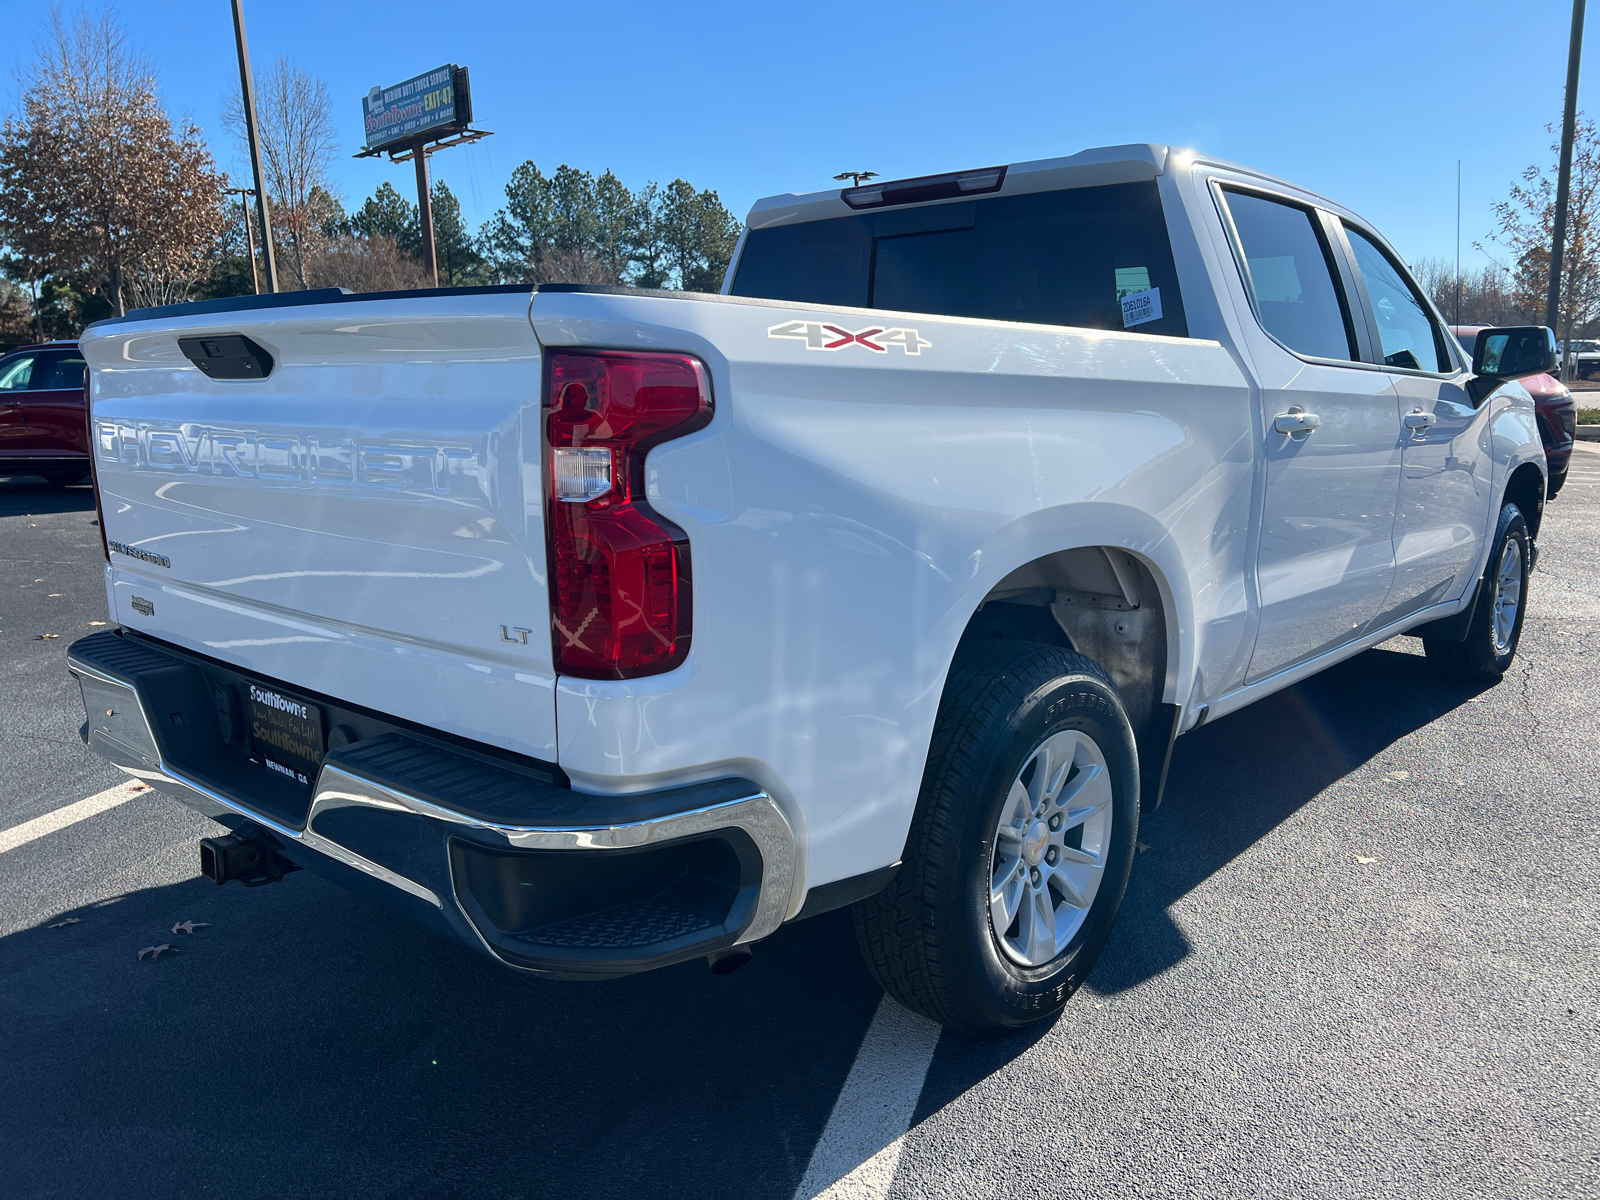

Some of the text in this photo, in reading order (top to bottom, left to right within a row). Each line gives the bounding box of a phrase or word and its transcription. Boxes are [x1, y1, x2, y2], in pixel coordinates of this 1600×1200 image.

[384, 87, 402, 104] MEDIUM
[402, 83, 414, 98] DUTY
[414, 76, 430, 93] TRUCK
[430, 69, 450, 86] SERVICE
[424, 90, 441, 112] EXIT
[442, 86, 452, 105] 47
[97, 424, 473, 495] CHEVROLET
[108, 540, 171, 569] SILVERADO
[499, 624, 533, 645] LT
[251, 704, 267, 721] Your
[268, 708, 287, 729] Dealer
[1044, 692, 1115, 724] GRABBER
[298, 773, 308, 785] GA
